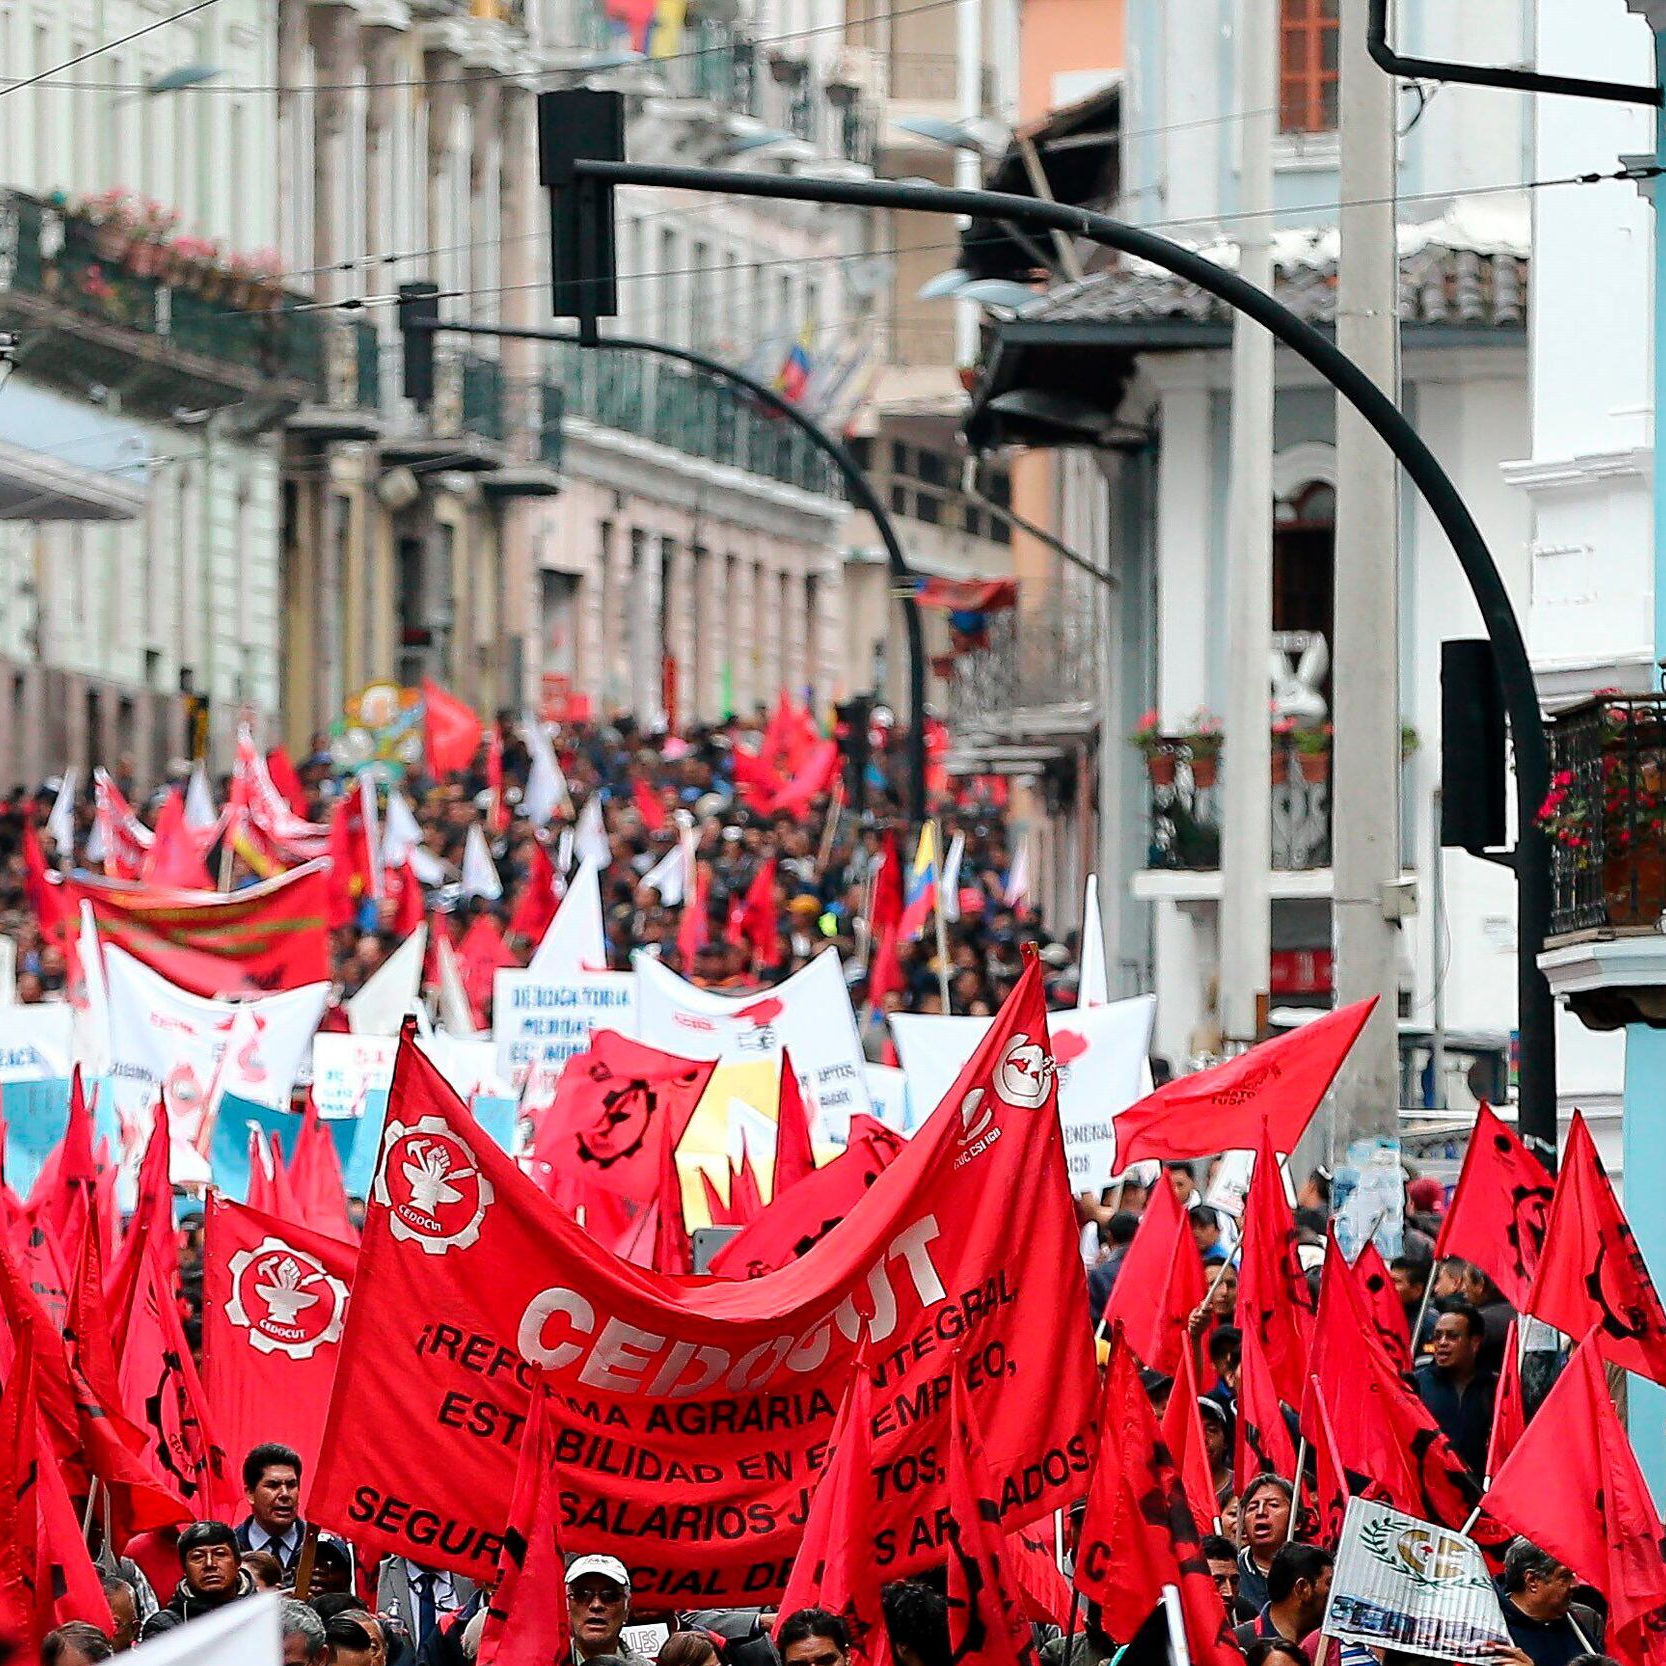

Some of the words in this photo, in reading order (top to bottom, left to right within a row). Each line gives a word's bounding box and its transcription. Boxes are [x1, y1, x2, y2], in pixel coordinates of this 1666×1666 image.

[259, 1319, 306, 1339] CEDOCUT
[645, 1387, 835, 1437] AGRARIA
[871, 1338, 1018, 1441] EMPEO,
[437, 1391, 725, 1485] ESTBILIDAD
[737, 1450, 793, 1482] EN
[557, 1491, 776, 1542] SALARIOS
[787, 1447, 946, 1526] JTOS,
